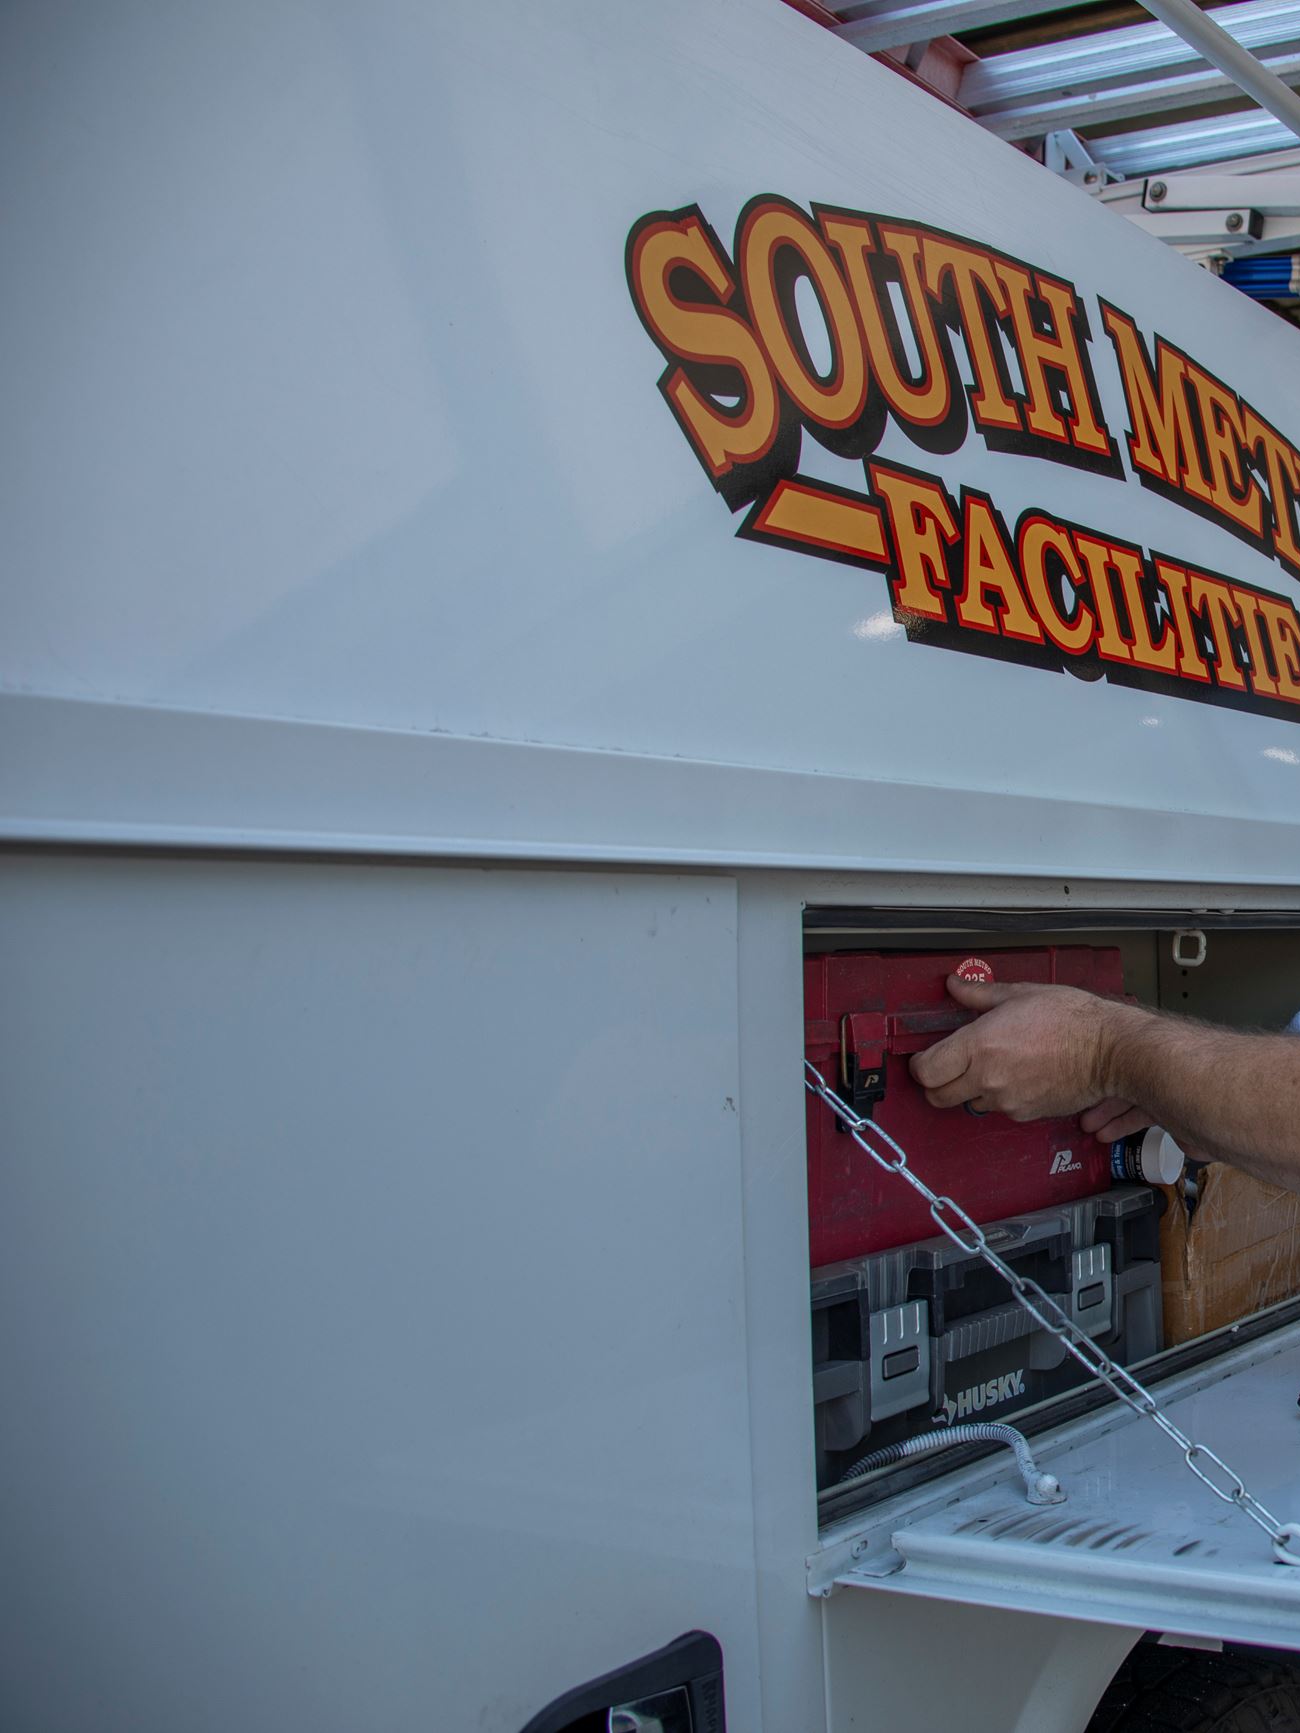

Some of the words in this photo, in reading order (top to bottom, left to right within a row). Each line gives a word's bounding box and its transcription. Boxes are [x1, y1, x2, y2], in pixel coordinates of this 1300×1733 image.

[628, 198, 1118, 490] SOUTH
[956, 957, 974, 976] SOUTH
[973, 957, 992, 975] METRO
[957, 1368, 1024, 1418] HUSKY
